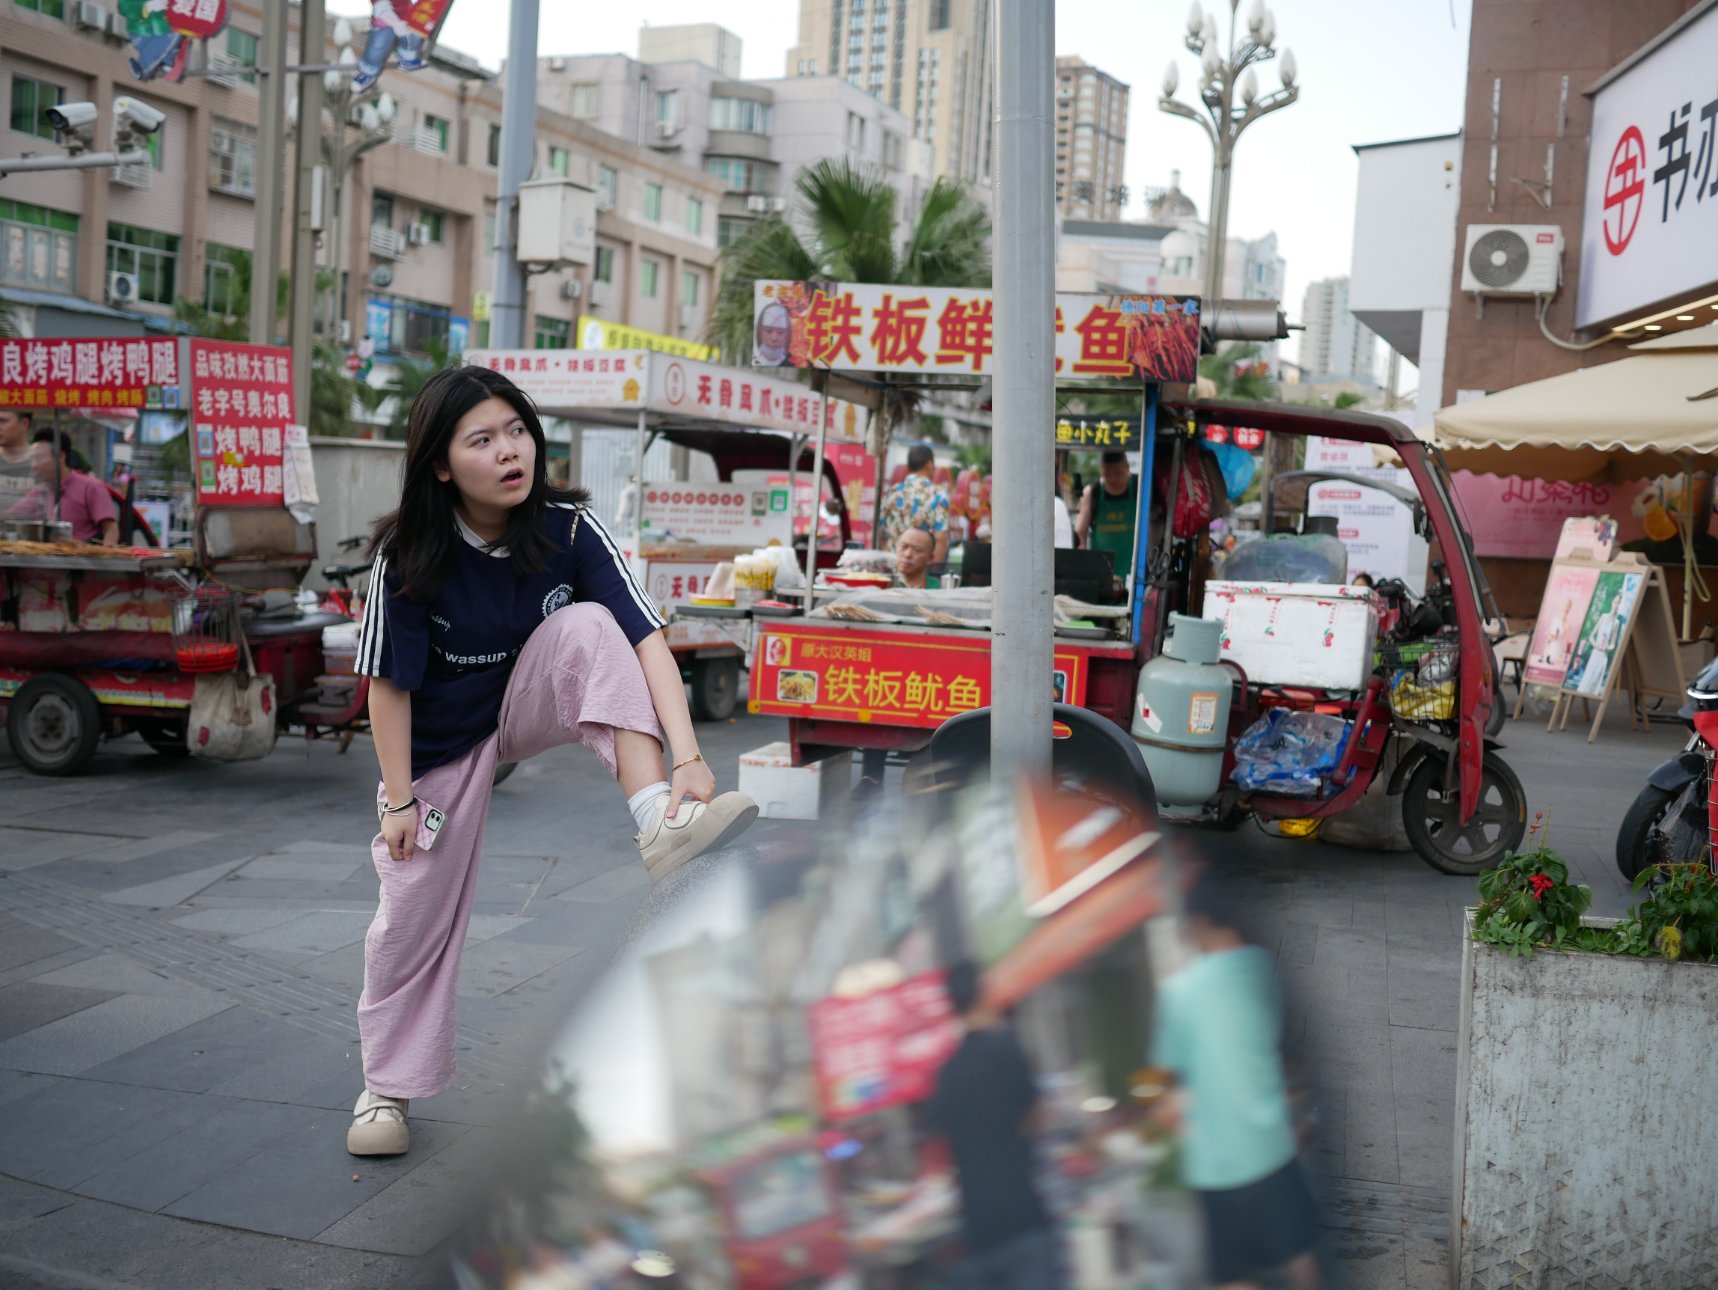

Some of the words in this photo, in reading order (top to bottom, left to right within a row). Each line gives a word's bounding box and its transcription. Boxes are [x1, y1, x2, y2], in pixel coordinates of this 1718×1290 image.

[805, 289, 1133, 377] 铁板鲜鱼
[2, 340, 178, 386] 良烤鸡腿烤鸭腿
[198, 389, 292, 421] 老字号奥尔良
[215, 426, 281, 457] 烤鸭腿
[217, 464, 282, 496] 烤鸡腿
[445, 651, 507, 665] wassup
[824, 664, 982, 713] 铁板鱿鱼
